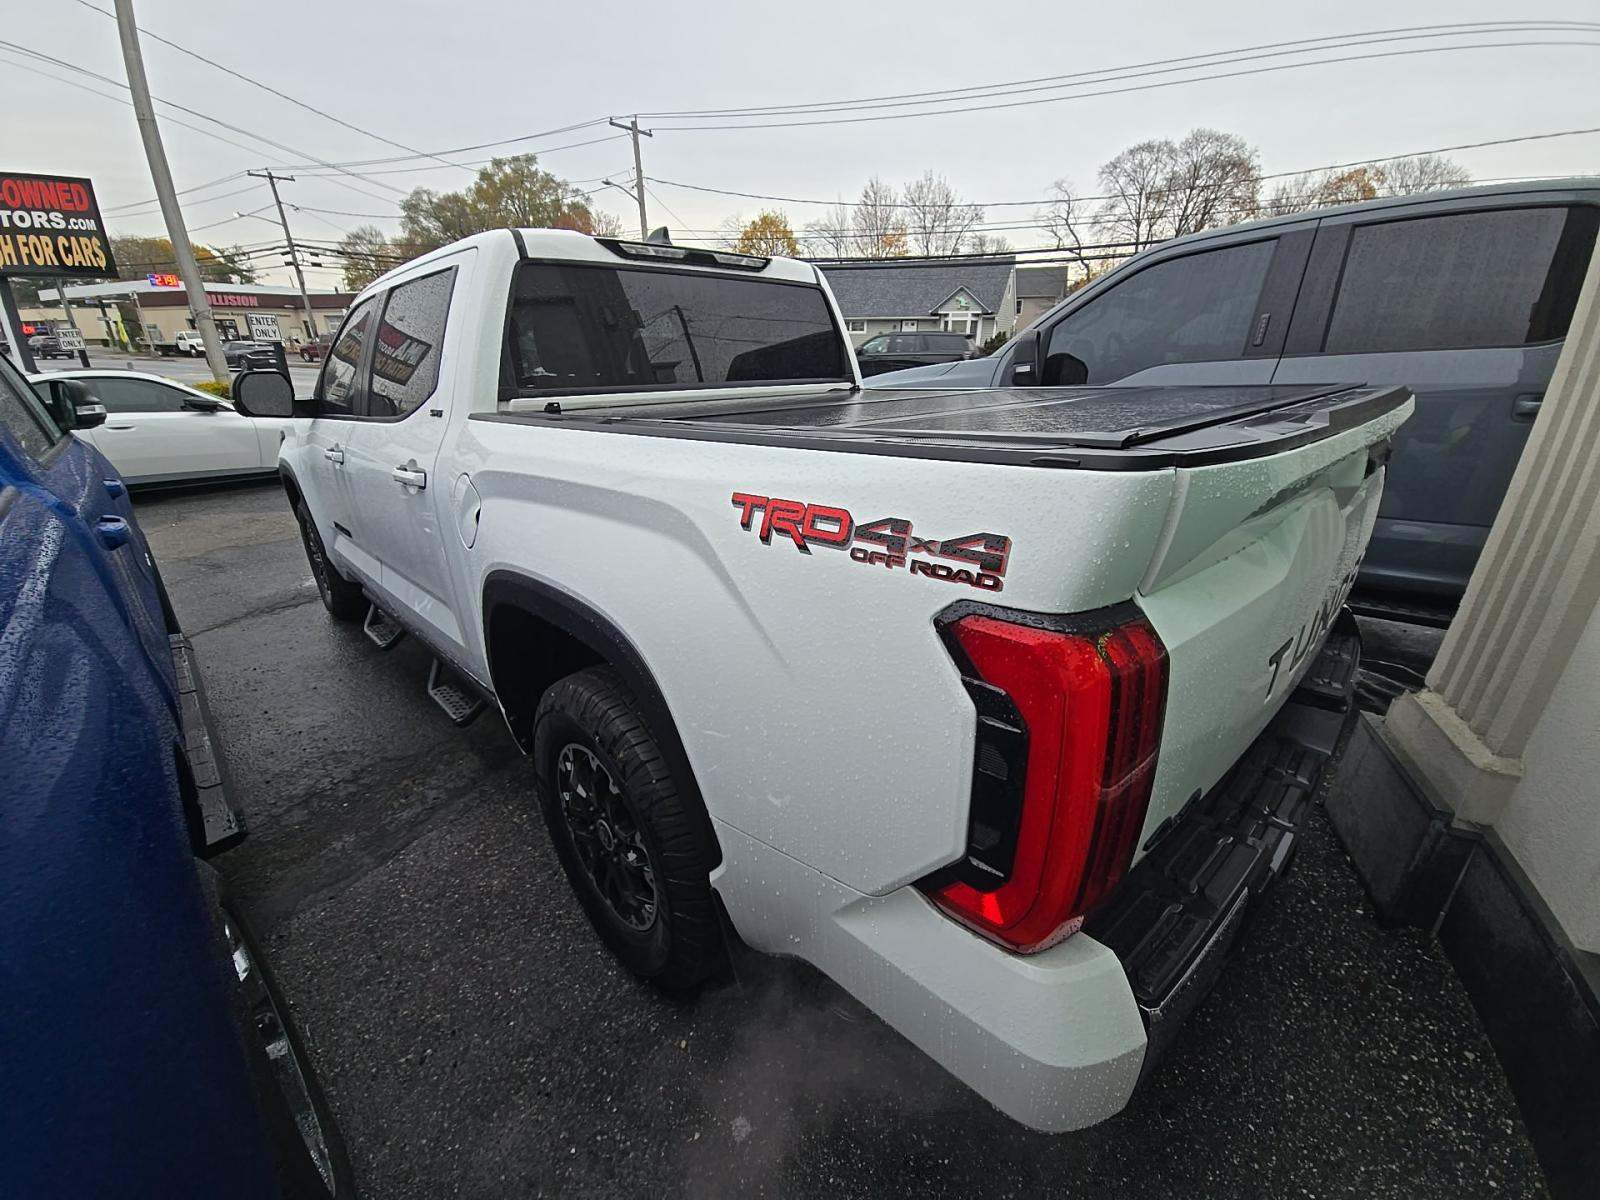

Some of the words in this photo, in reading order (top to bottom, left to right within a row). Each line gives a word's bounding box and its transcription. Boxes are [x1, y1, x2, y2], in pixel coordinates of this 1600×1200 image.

[17, 234, 59, 265] FOR
[204, 294, 258, 306] OLLISION
[249, 316, 278, 326] ENTER
[255, 328, 277, 338] ONLY
[62, 340, 82, 348] ONLY
[731, 491, 855, 556] TRD
[849, 547, 907, 569] OFF
[909, 559, 1004, 593] ROAD
